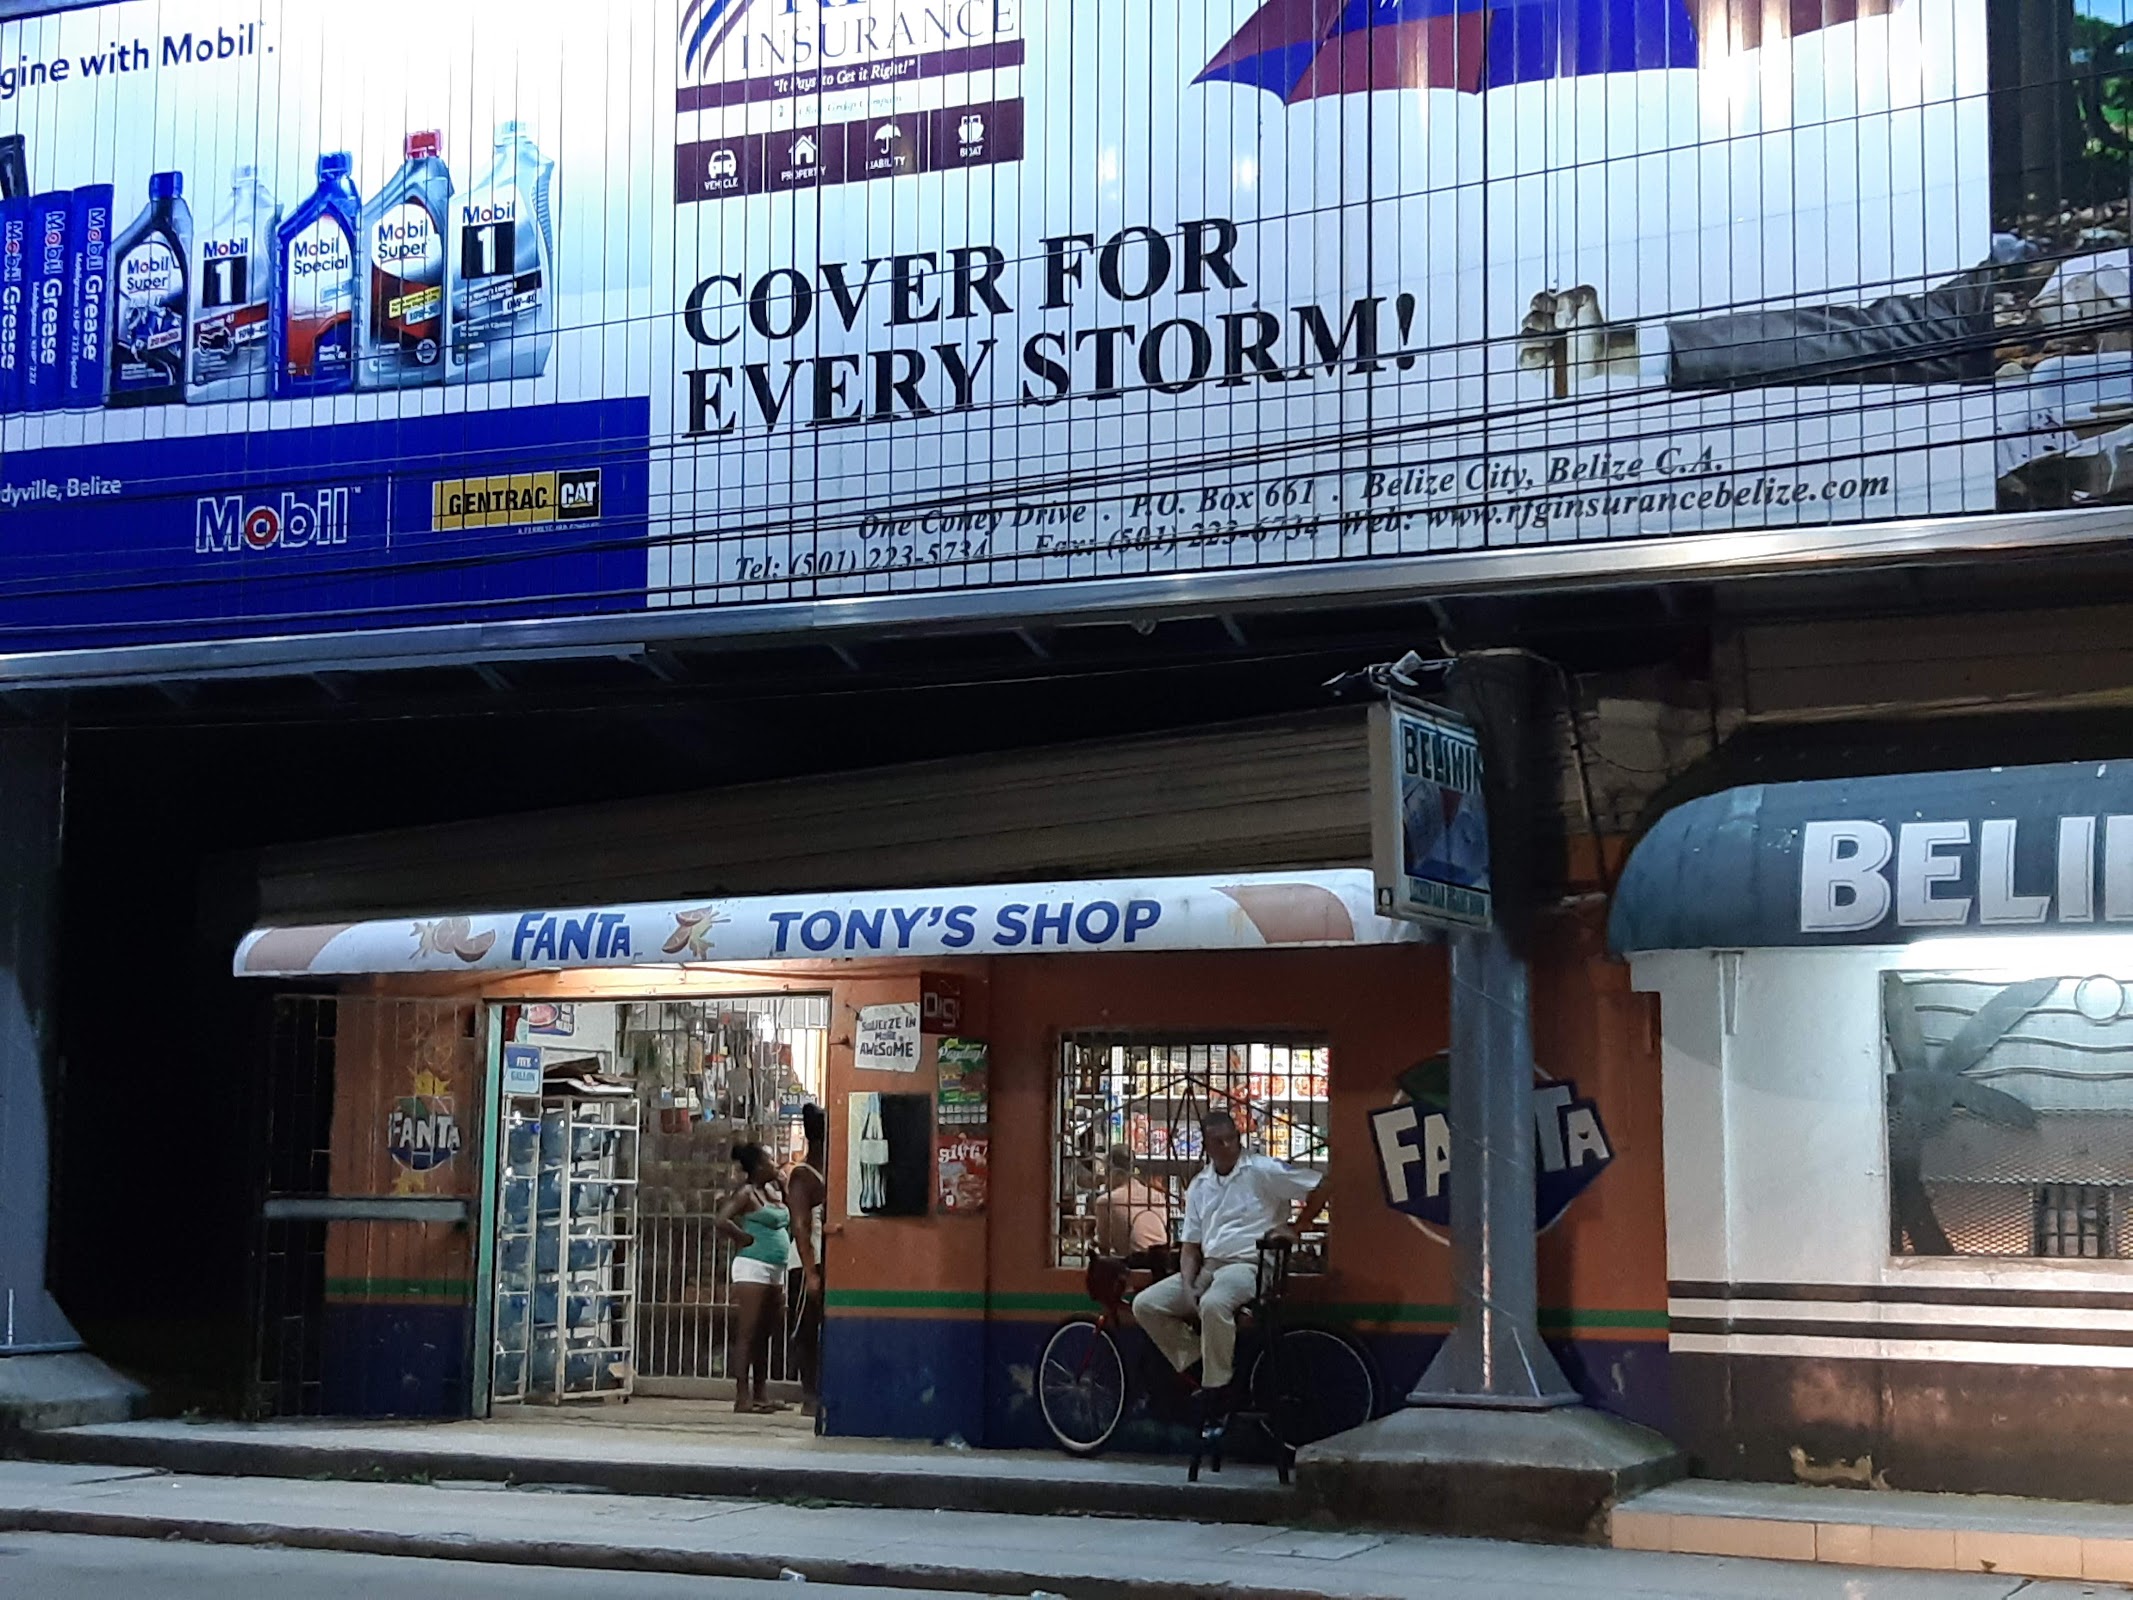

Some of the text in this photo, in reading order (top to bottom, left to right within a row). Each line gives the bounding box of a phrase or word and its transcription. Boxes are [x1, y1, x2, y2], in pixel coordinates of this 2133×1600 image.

[742, 0, 1014, 69] INSURANCE
[80, 38, 149, 78] with
[822, 73, 834, 86] to
[837, 69, 855, 85] Get
[859, 66, 868, 81] it
[378, 218, 429, 242] Mobil
[462, 200, 516, 224] Mobil
[127, 256, 170, 275] Mobil
[203, 237, 249, 259] Mobil
[293, 253, 349, 278] Special
[294, 236, 340, 259] Mobil
[377, 241, 428, 261] Super
[477, 225, 496, 275] 1
[0, 220, 23, 371] Mobil Grease
[40, 210, 66, 368] Mobil Grease
[82, 206, 105, 362] Mobil Grease
[127, 275, 169, 292] Super
[215, 260, 233, 304] 1
[683, 216, 1249, 347] COVER FOR
[682, 291, 1417, 440] EVERY STORM!
[0, 475, 122, 508] dyville, Belize
[448, 480, 599, 516] GENTRAC CAT
[858, 446, 1723, 540] One Coney Drive P.O. Box 661 Belize City, Belize C.A.
[735, 556, 781, 581] Tel:
[792, 548, 857, 577] (501)
[511, 911, 632, 963] FANTA
[768, 898, 1162, 954] TONY'S SHOP
[860, 1041, 914, 1058] AWESOME
[388, 1111, 461, 1150] FANTA
[1372, 1084, 1610, 1204] FATA
